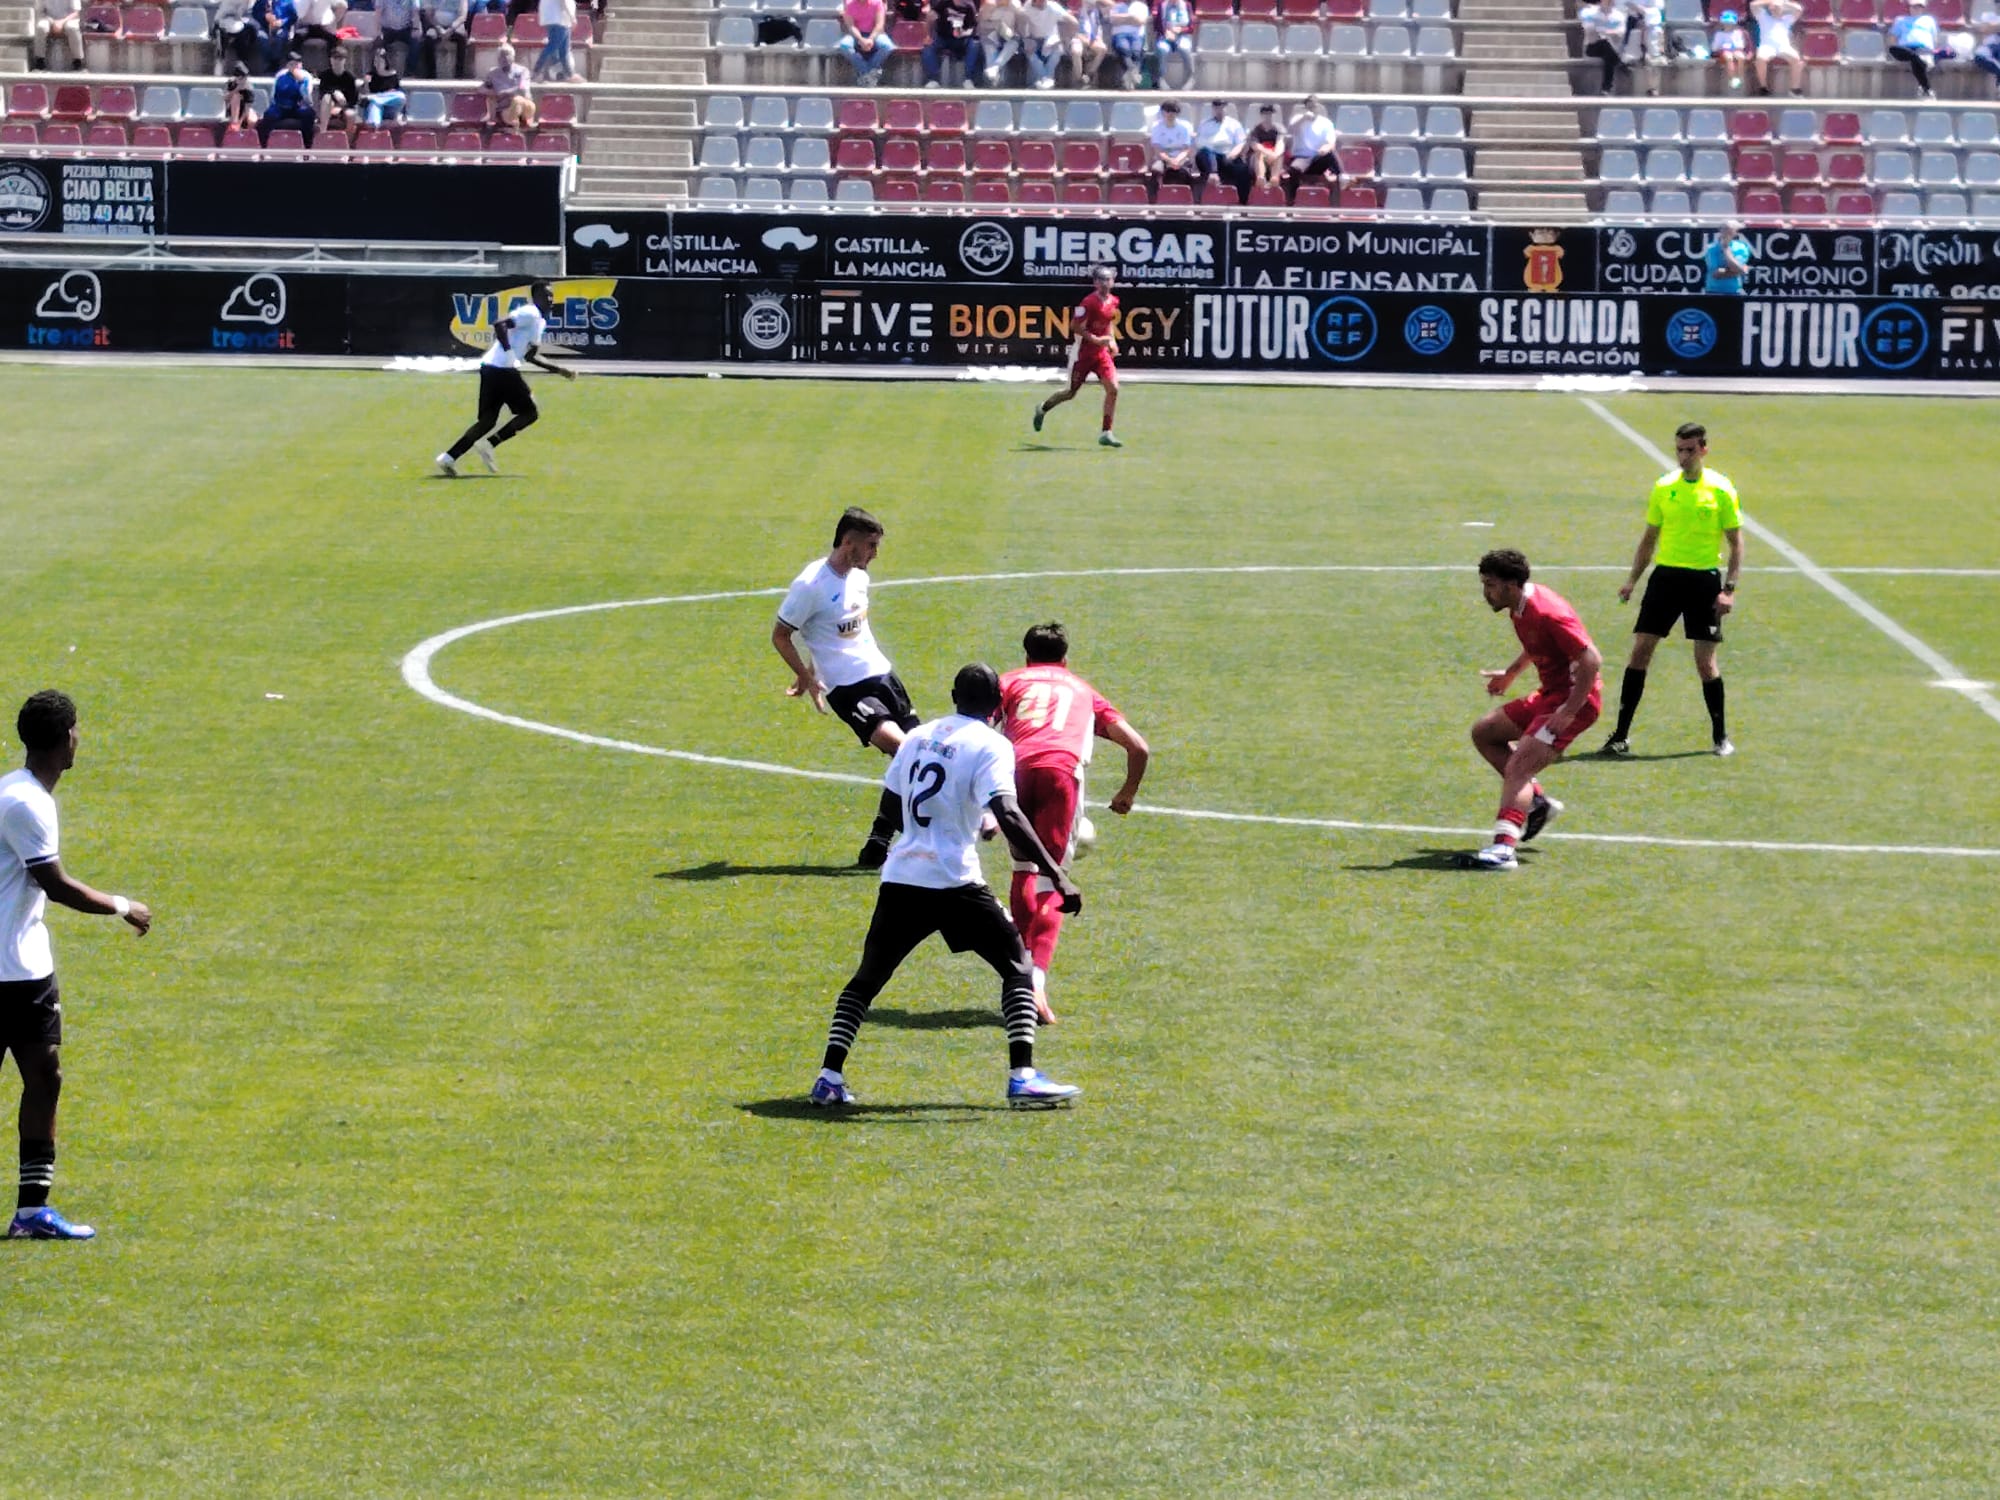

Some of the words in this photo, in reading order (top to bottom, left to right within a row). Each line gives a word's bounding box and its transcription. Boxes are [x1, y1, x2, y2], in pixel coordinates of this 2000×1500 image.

[63, 179, 100, 200] CIAO
[104, 180, 153, 201] BELLA
[63, 203, 91, 221] 969
[115, 204, 134, 222] 44
[137, 204, 155, 223] 74
[646, 234, 740, 250] CASTILLA-
[834, 237, 930, 254] CASTILLA-
[1236, 229, 1340, 253] ESTADIO
[1347, 231, 1480, 256] MUNICIPAL
[1656, 231, 1817, 261] CUNCA
[646, 257, 669, 273] LA
[674, 258, 758, 274] MANCHA
[834, 261, 858, 276] LA
[862, 261, 947, 278] MANCHA
[1122, 263, 1214, 280] Industriales
[1605, 264, 1702, 284] CIUDAD
[1284, 267, 1479, 291] FUENSANTA
[821, 301, 933, 337] FIVE
[950, 304, 1181, 341] BIOENRGY
[1194, 294, 1310, 359] FUTUR
[1480, 298, 1640, 344] SEGUNDA
[28, 323, 111, 346] trendit
[212, 327, 295, 349] trendit
[1742, 301, 1860, 367] FUTUR
[821, 340, 930, 353] BALANCED
[957, 343, 1008, 355] WITH
[1479, 347, 1640, 365] FEDERACIÓN
[852, 700, 875, 723] 14
[908, 758, 946, 828] 12
